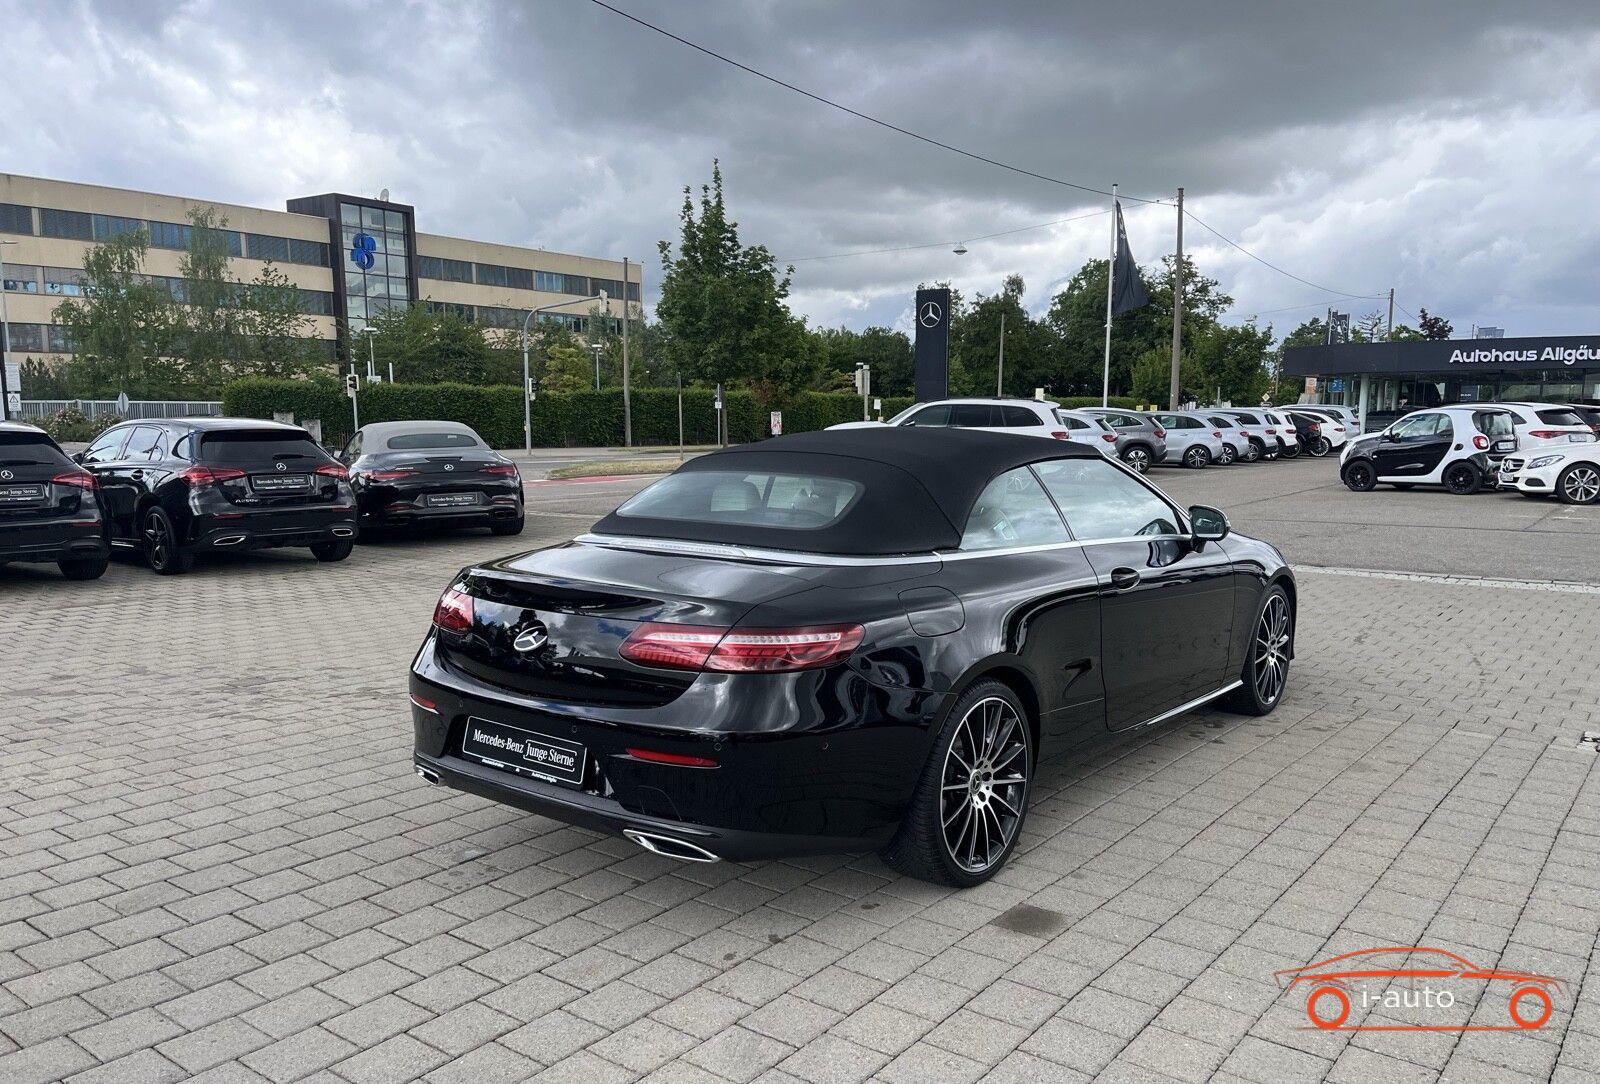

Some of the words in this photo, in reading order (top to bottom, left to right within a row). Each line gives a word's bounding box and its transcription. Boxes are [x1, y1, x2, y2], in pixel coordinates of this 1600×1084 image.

[1450, 348, 1537, 363] Autohaus
[1540, 344, 1600, 365] Allgäu
[473, 729, 525, 754] Mercedes-Benz
[525, 743, 548, 761] Junge
[548, 748, 575, 767] Sterne
